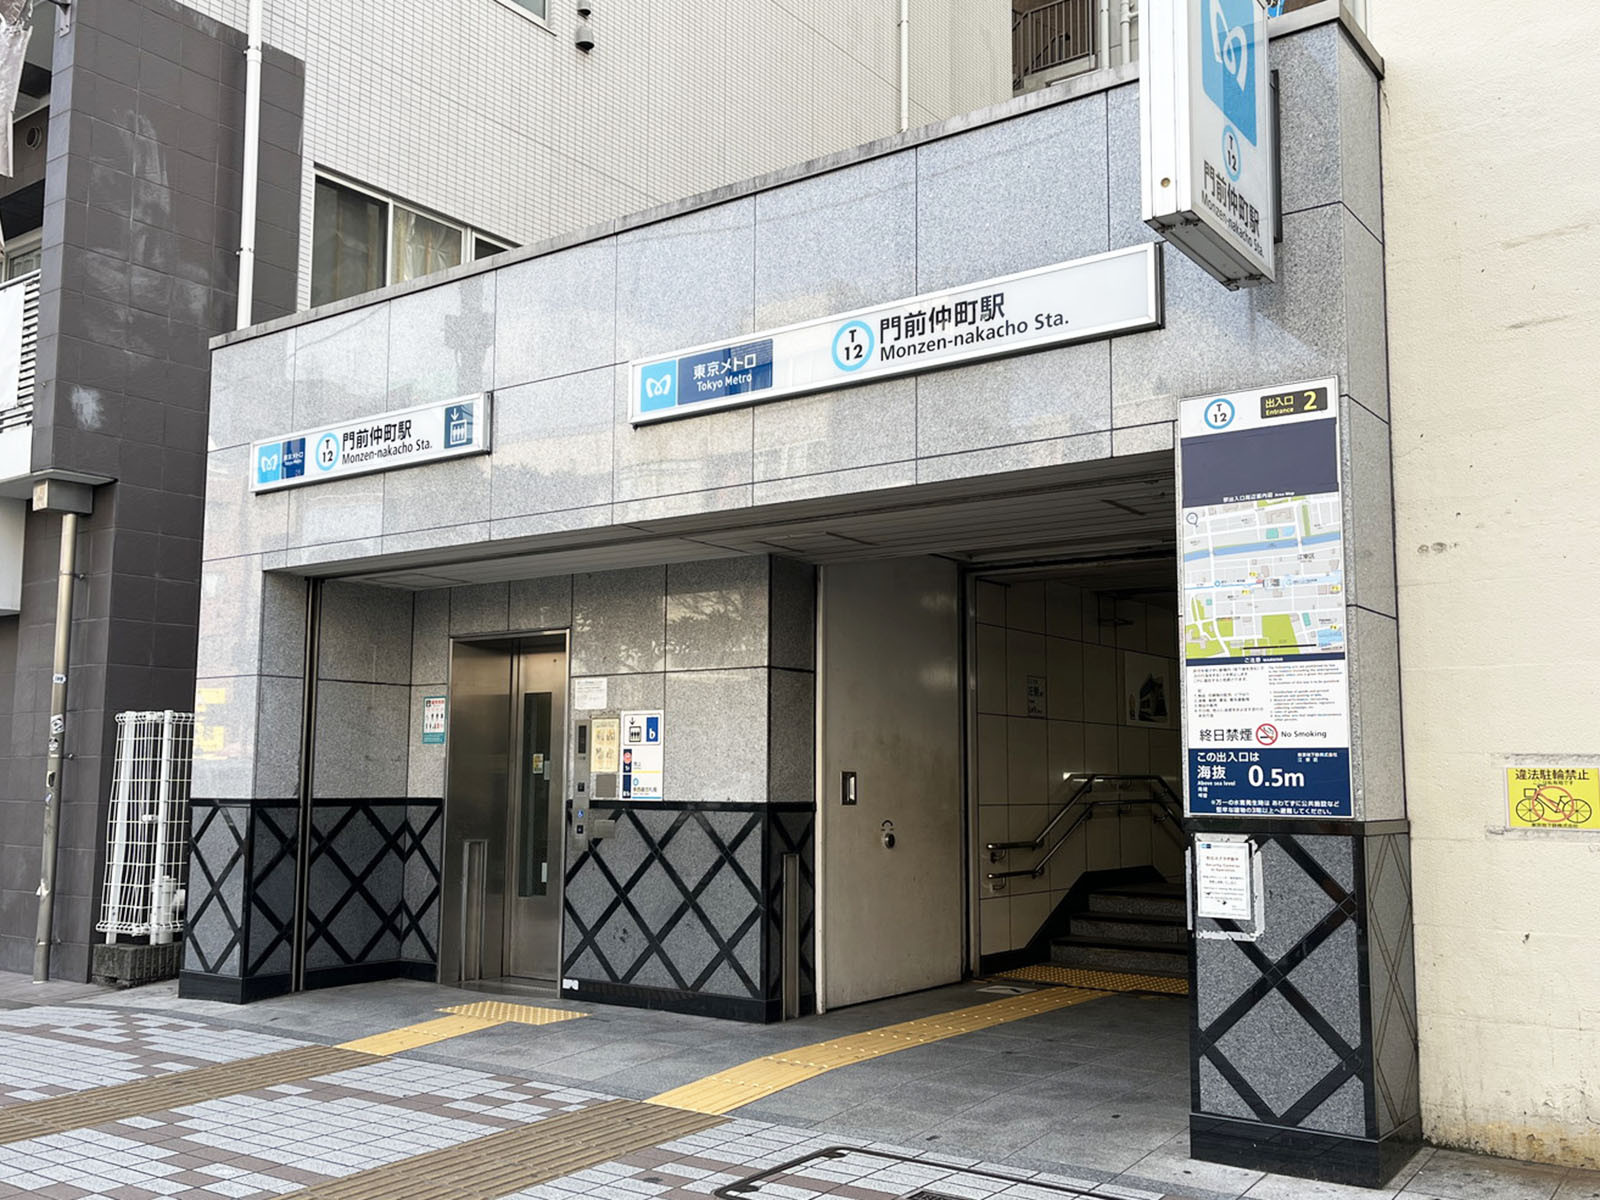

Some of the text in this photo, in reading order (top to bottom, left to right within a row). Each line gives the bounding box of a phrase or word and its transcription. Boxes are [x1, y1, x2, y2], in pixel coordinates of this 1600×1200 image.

[1227, 150, 1237, 171] 12
[1203, 160, 1260, 238] 門前仲町駅
[1201, 190, 1265, 258] Monzen-nakacho Sta.
[879, 292, 1005, 344] 門前仲町駅
[849, 329, 857, 342] T
[880, 312, 1070, 361] Monzen-nakacho Sta.
[844, 344, 863, 361] 12
[693, 353, 757, 380] 東京メトロ
[696, 373, 753, 392] Tokyo Metro
[1216, 404, 1222, 412] T
[1265, 396, 1294, 408] 出入口
[1303, 391, 1317, 410] 2
[1213, 413, 1227, 423] 12
[1265, 407, 1294, 416] Entrance
[342, 419, 412, 452] 門前仲町駅
[325, 439, 330, 449] T
[341, 438, 433, 465] Monzen-nakacho Sta.
[322, 450, 333, 463] 12
[648, 728, 656, 740] b
[1199, 728, 1253, 742] 終日禁煙
[1294, 731, 1327, 739] Smoking
[1197, 751, 1260, 763] この出入口は
[1197, 765, 1227, 780] 海抜
[1248, 764, 1305, 787] 0.5m
[1515, 768, 1590, 780] 違法駐輪禁止
